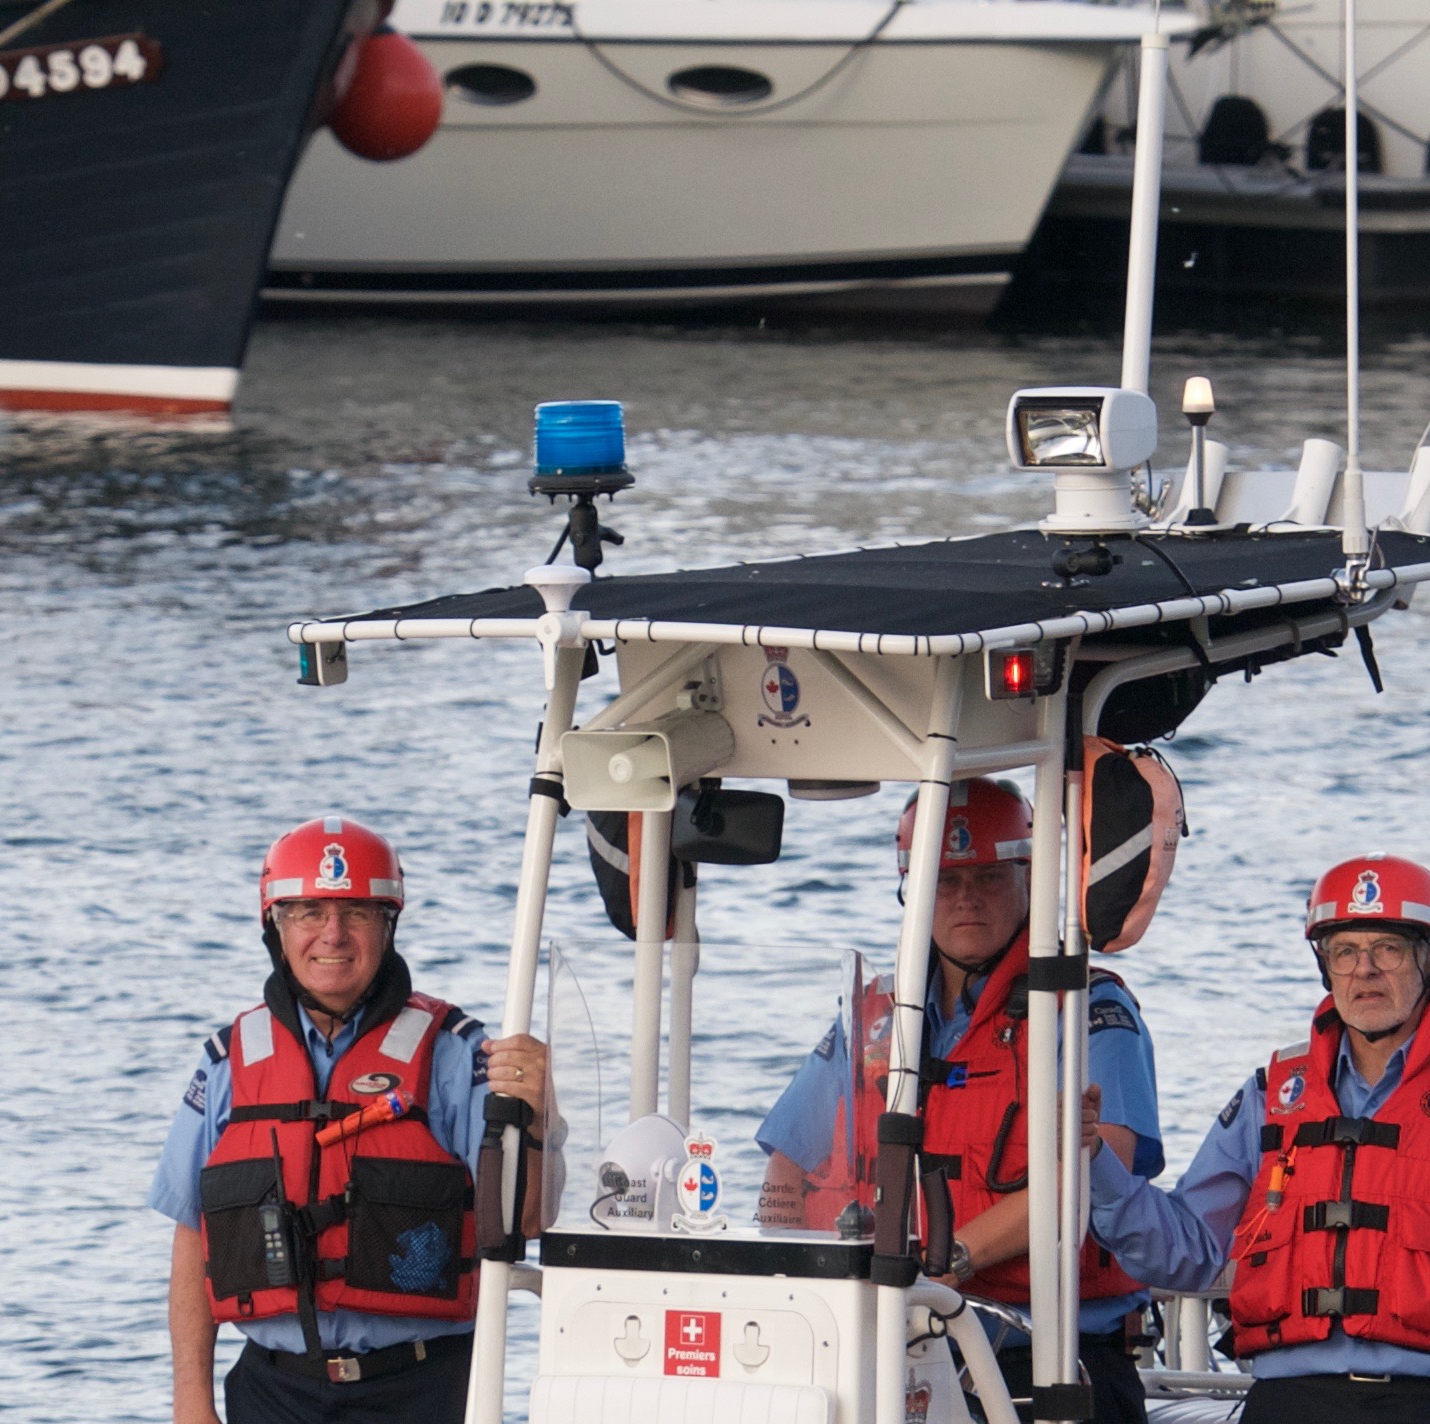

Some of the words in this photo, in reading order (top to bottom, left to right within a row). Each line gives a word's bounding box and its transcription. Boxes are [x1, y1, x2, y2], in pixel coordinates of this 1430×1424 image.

[762, 1181, 794, 1194] Garde
[615, 1193, 647, 1203] Guard
[607, 1207, 655, 1221] Auxiliary
[667, 1347, 716, 1362] Premiers
[676, 1363, 707, 1376] soins
